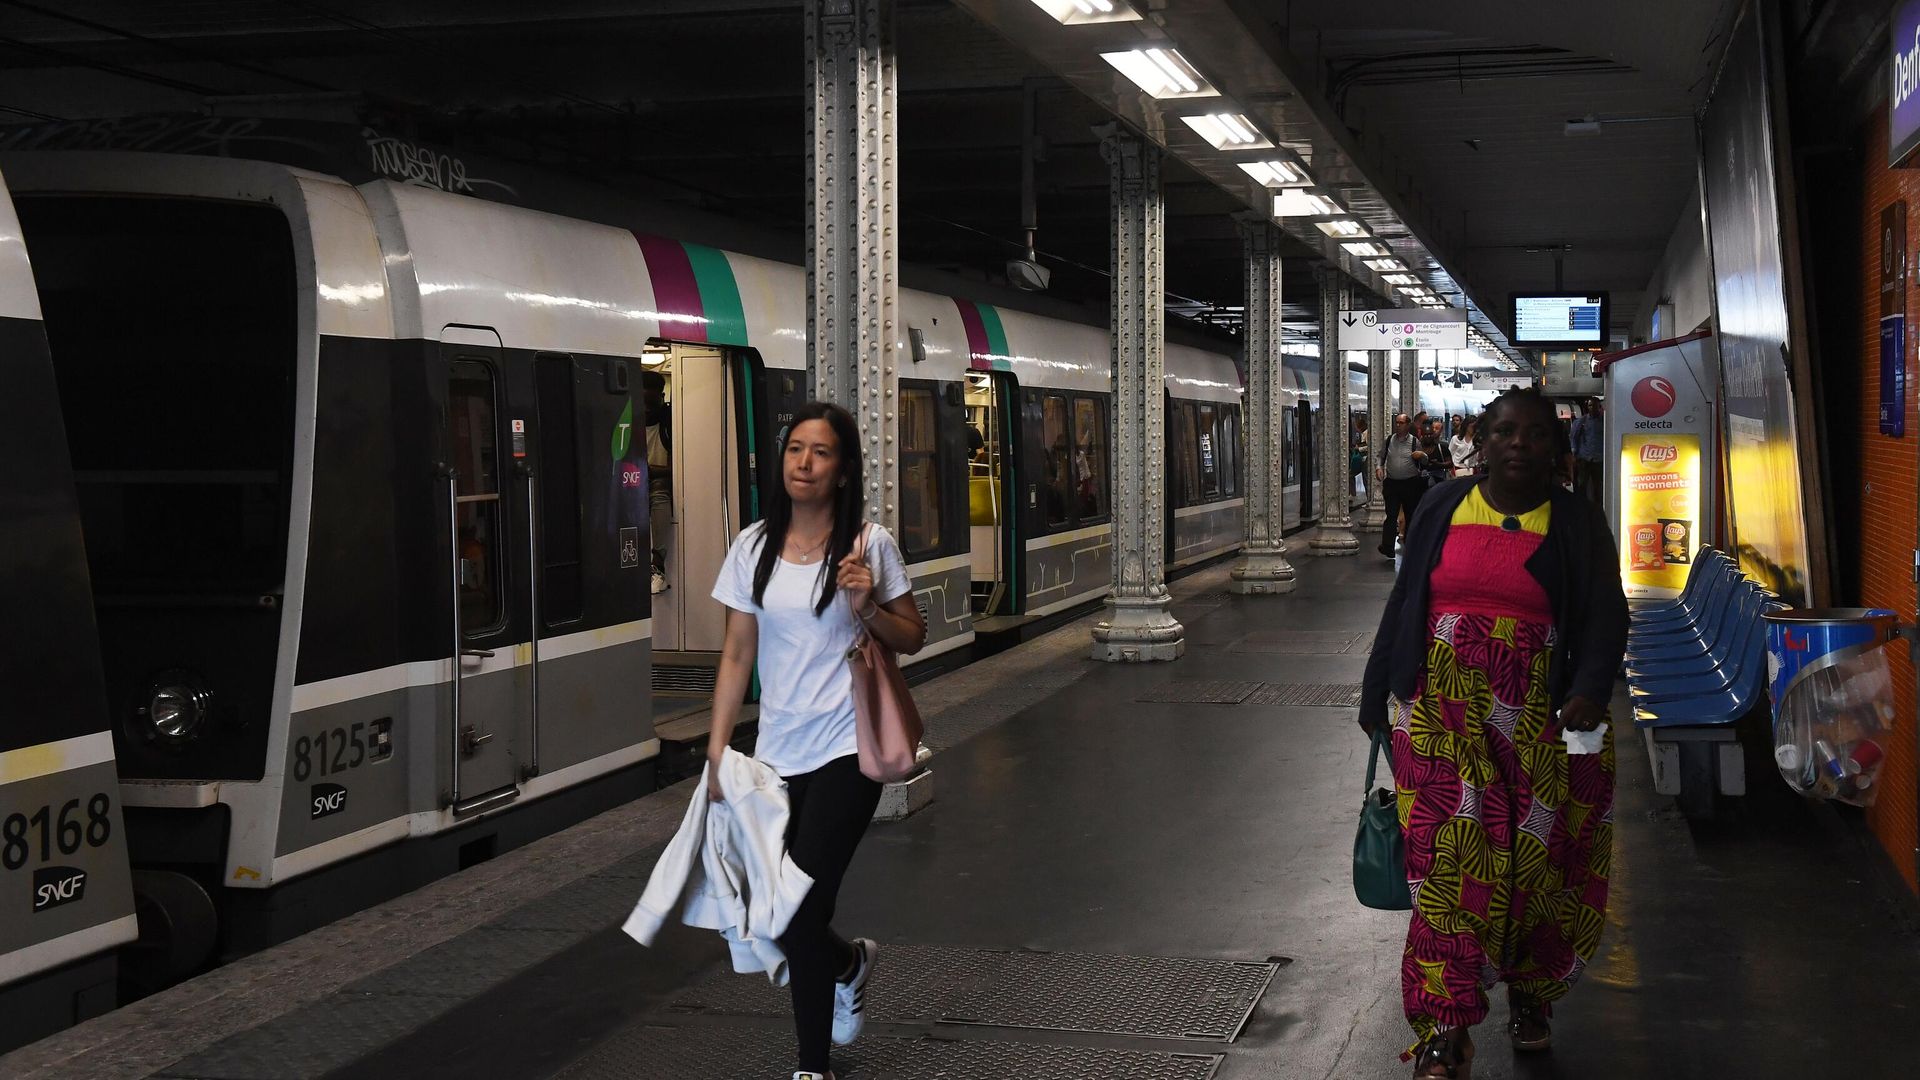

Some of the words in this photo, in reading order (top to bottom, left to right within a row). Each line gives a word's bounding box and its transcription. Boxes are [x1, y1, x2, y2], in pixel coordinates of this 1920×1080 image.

[1894, 24, 1920, 110] Denf
[1634, 420, 1672, 429] selecta
[1641, 444, 1675, 462] Lay's
[622, 471, 641, 484] SNCF
[293, 722, 365, 782] 8125
[312, 789, 346, 815] SNCF
[2, 792, 111, 870] 8168
[35, 873, 85, 907] SNCF
